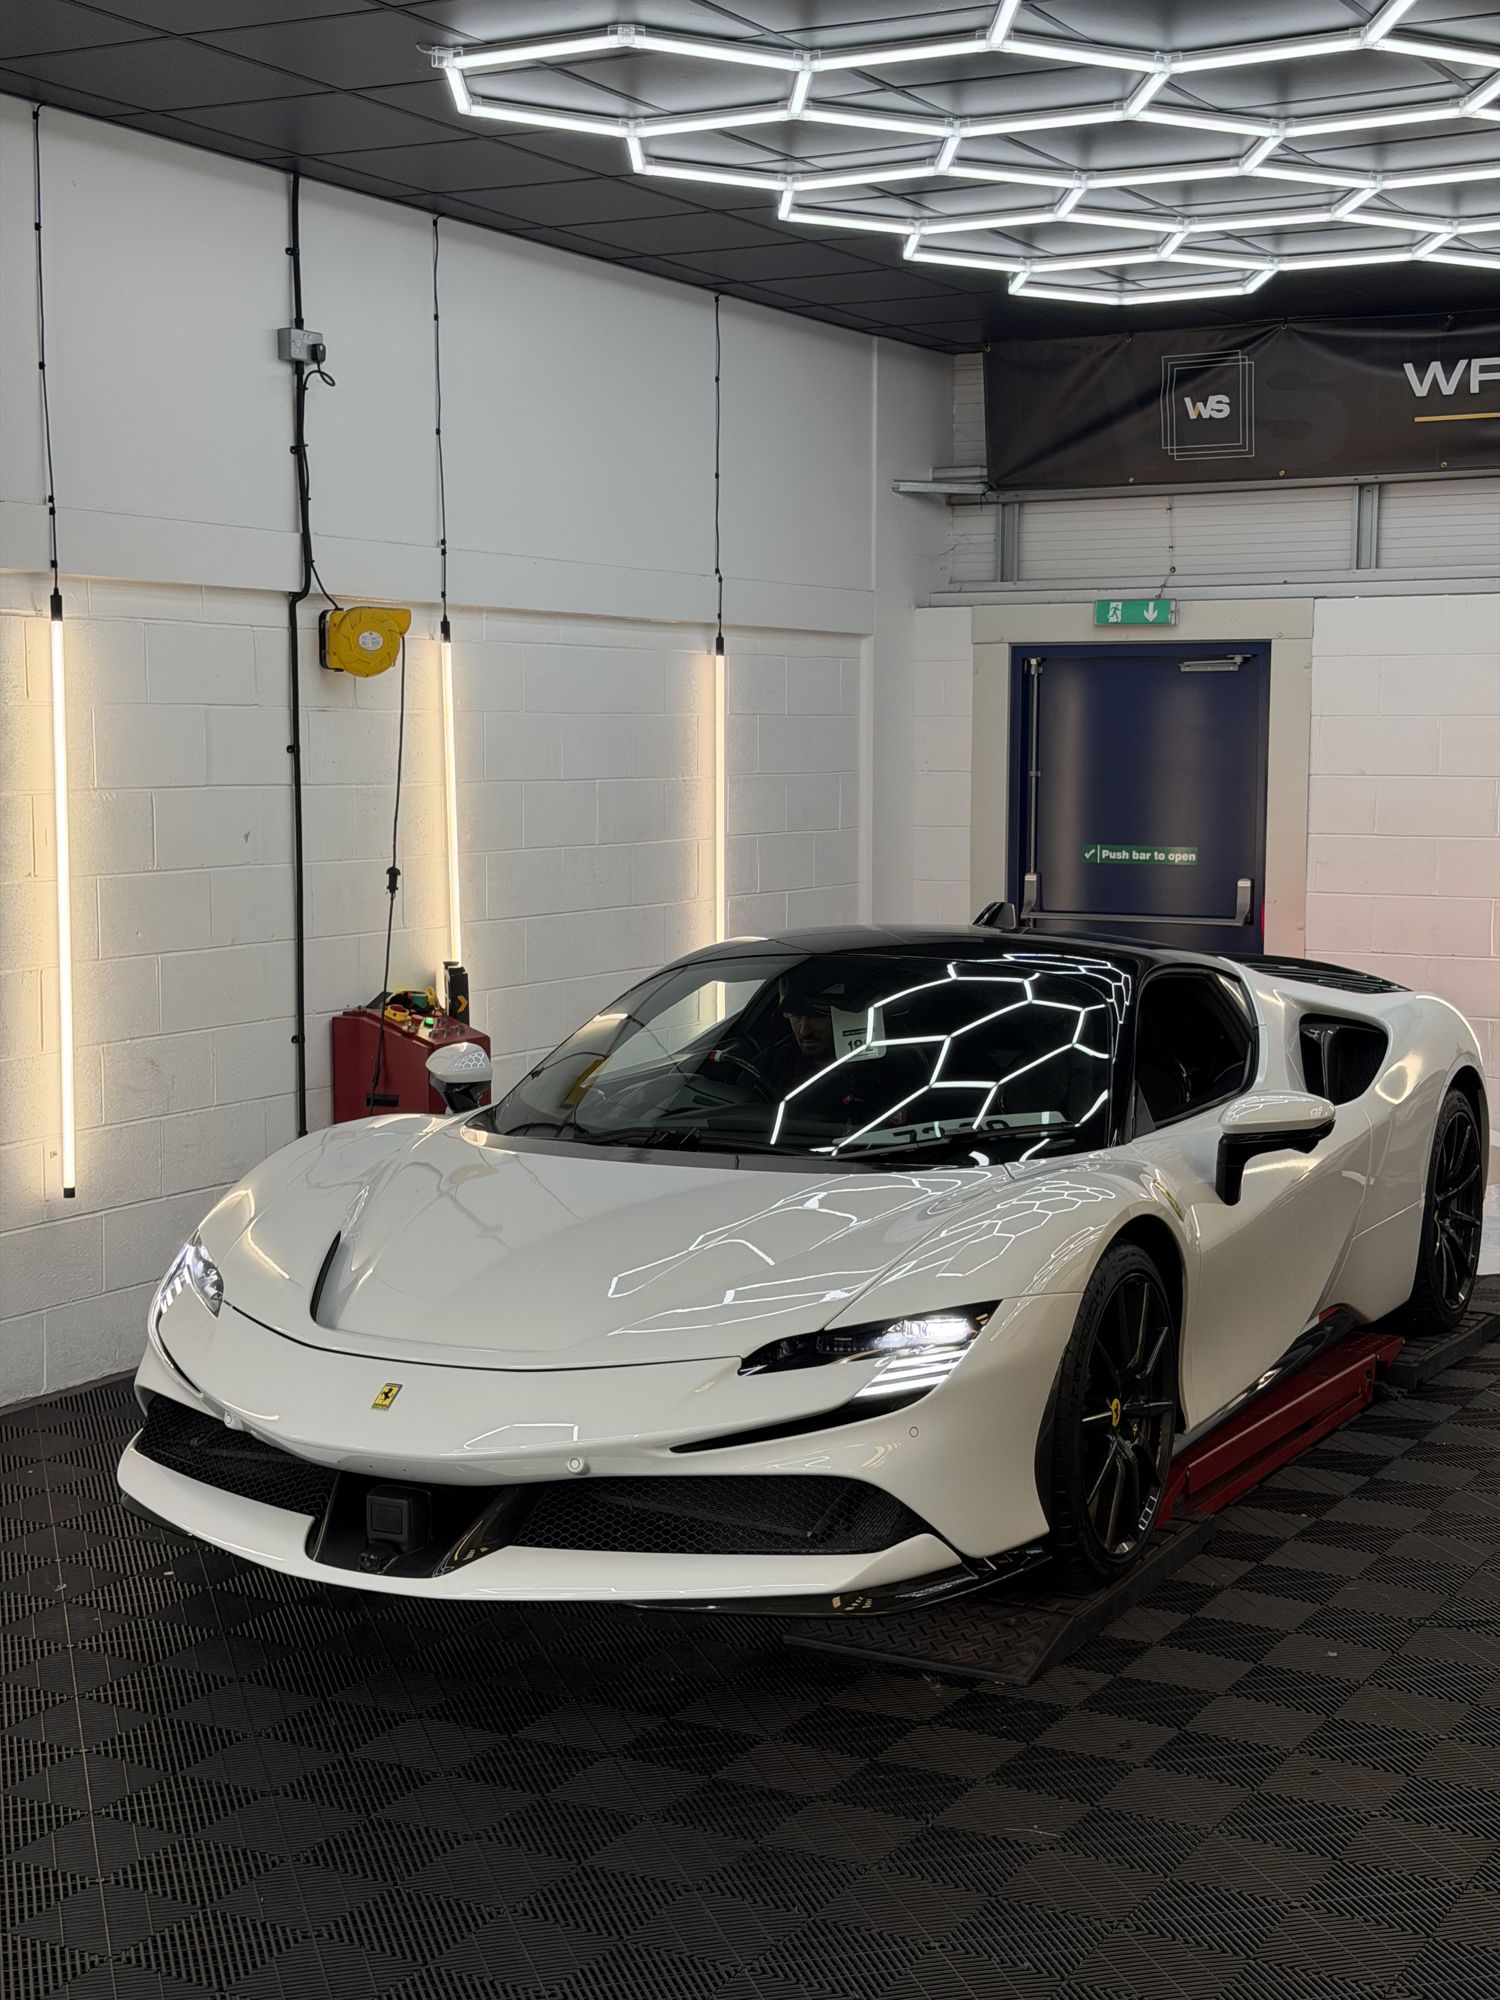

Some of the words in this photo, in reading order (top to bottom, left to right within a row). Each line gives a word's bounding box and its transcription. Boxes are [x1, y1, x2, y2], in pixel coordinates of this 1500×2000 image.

[1184, 394, 1230, 420] WS
[1101, 849, 1129, 860] Push
[1132, 850, 1151, 860] bar
[1154, 851, 1165, 861] to
[1167, 852, 1196, 863] open
